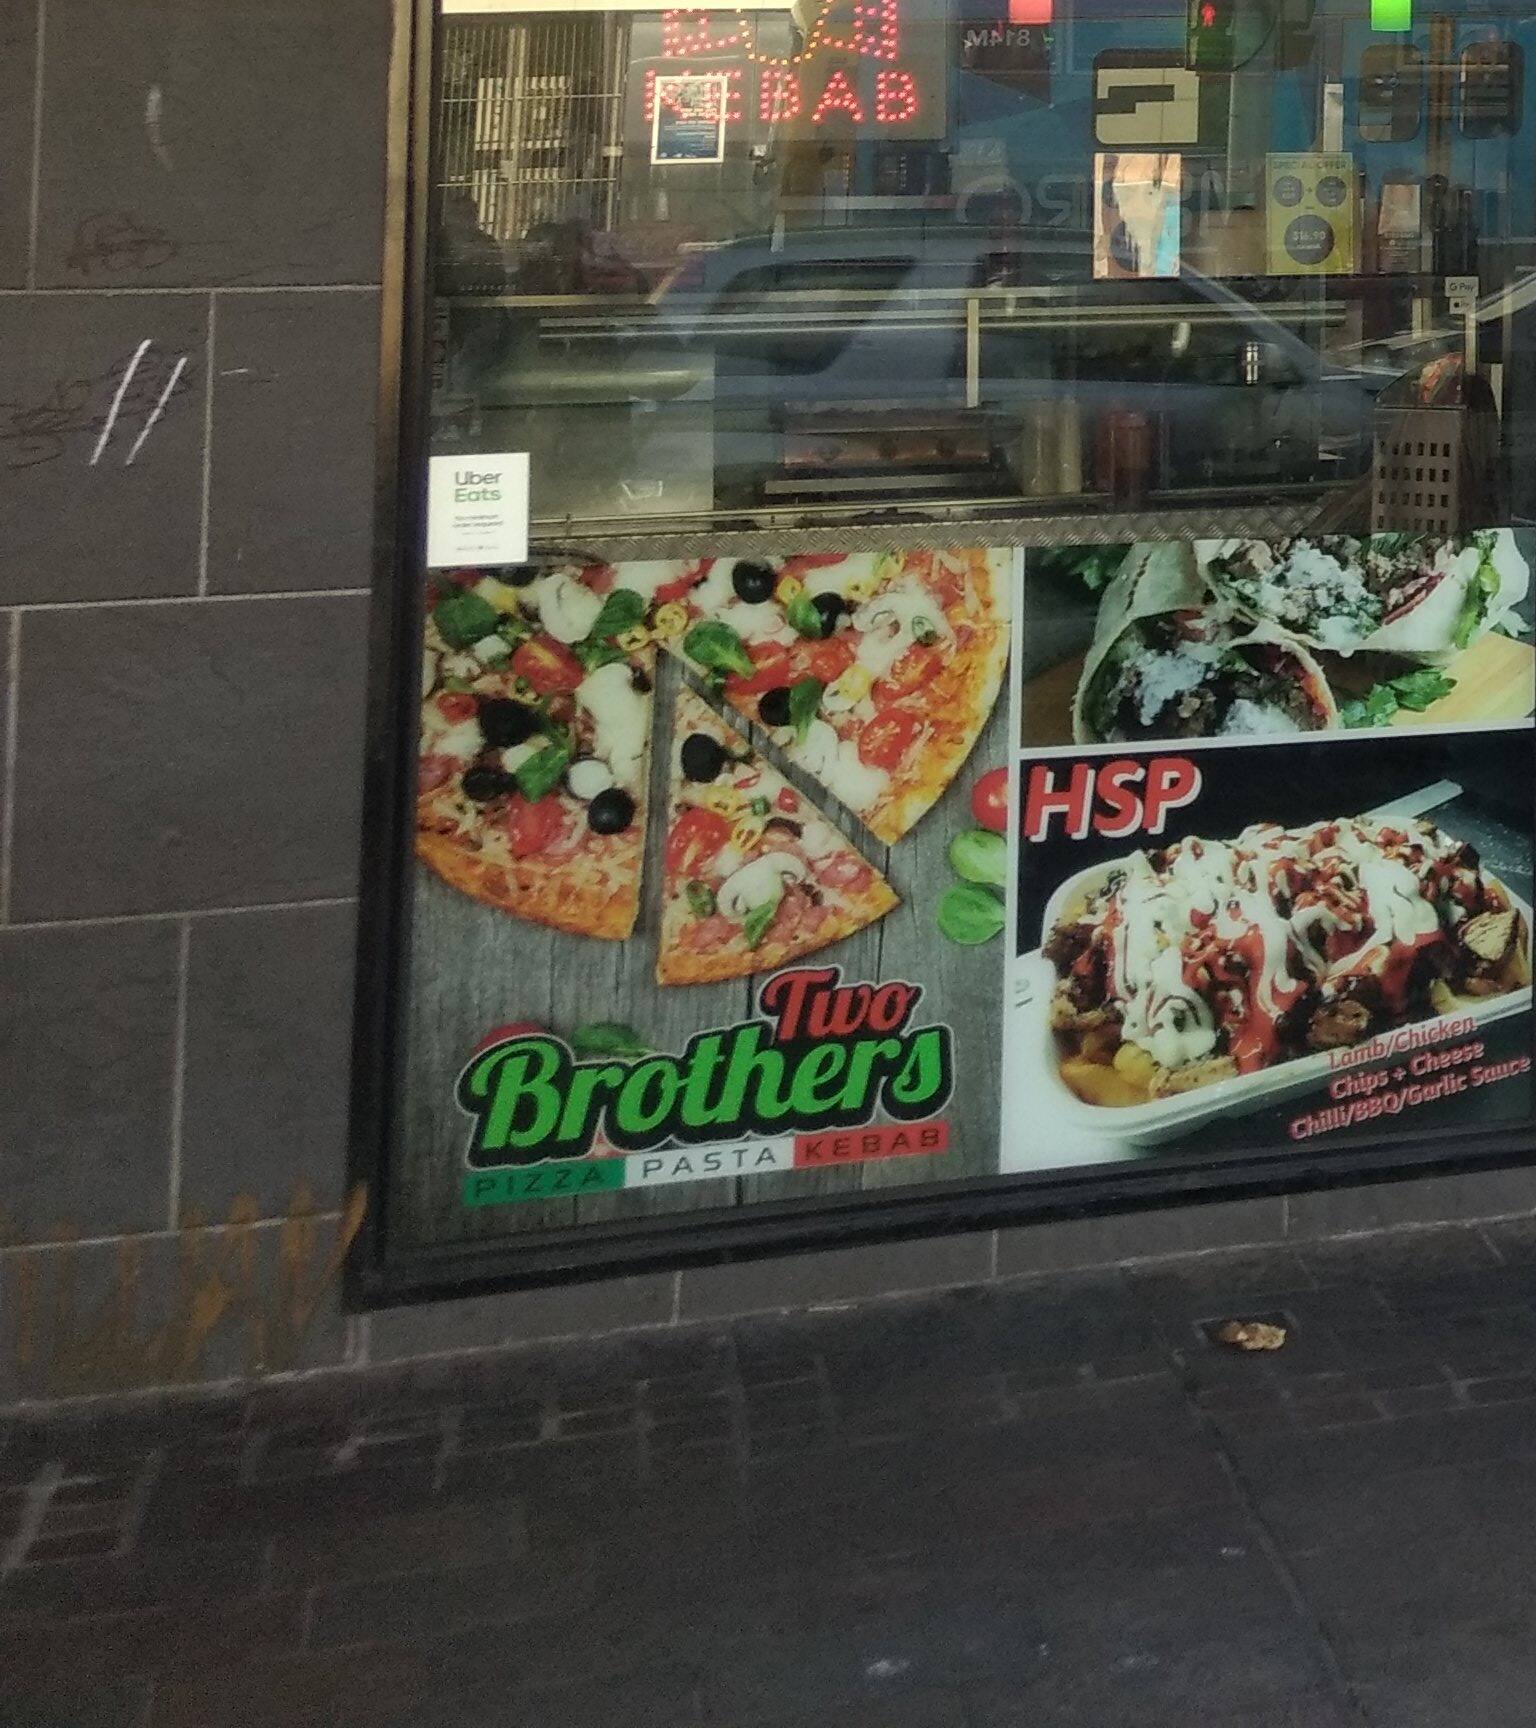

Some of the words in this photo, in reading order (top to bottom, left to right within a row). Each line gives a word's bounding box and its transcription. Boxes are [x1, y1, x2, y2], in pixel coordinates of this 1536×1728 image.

[644, 69, 918, 124] KEBAB
[455, 471, 503, 486] Uber
[455, 488, 502, 502] Eats
[1024, 756, 1203, 842] HSP
[763, 968, 918, 1042] Two
[1328, 1015, 1477, 1070] Lamb/Chicken
[1330, 1071, 1389, 1099] Chips
[1409, 1041, 1484, 1076] Cheese
[470, 1026, 942, 1152] Brothers
[1470, 1056, 1532, 1087] Sauce
[474, 1166, 606, 1200] PIZZA
[642, 1145, 776, 1180] PASTA
[805, 1129, 940, 1161] KEBAB
